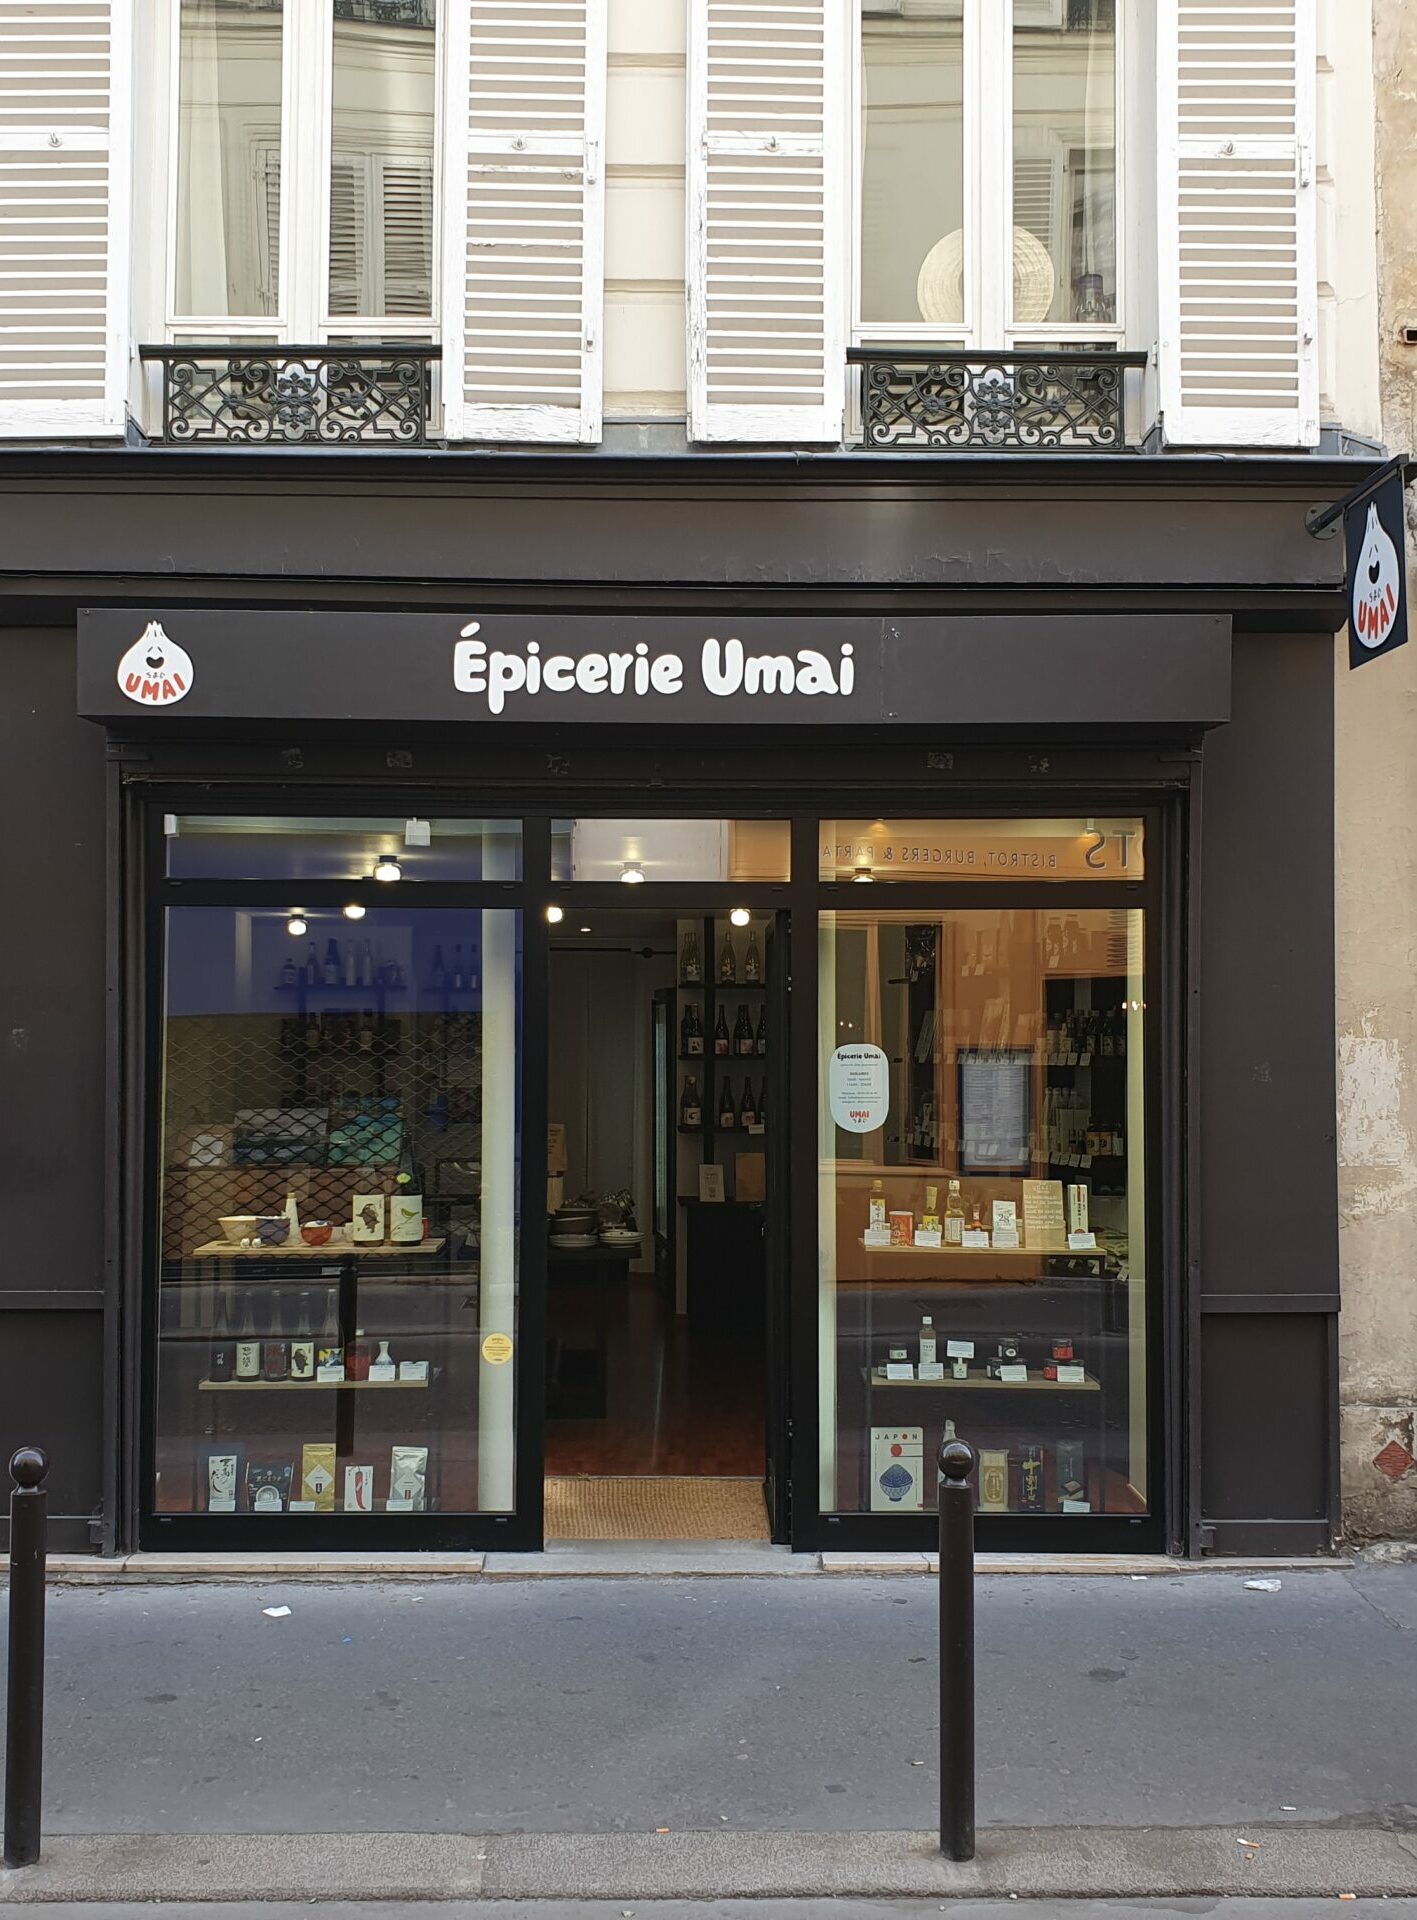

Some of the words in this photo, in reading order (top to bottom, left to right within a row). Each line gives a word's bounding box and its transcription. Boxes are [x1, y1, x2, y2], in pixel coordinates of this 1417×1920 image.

[1358, 583, 1395, 640] UMAI
[453, 621, 684, 715] Épicerie
[701, 638, 855, 697] Umai
[125, 672, 186, 701] UMAI
[863, 1052, 881, 1060] Umai
[849, 1110, 870, 1118] UMAI
[874, 1432, 919, 1441] JAPON
